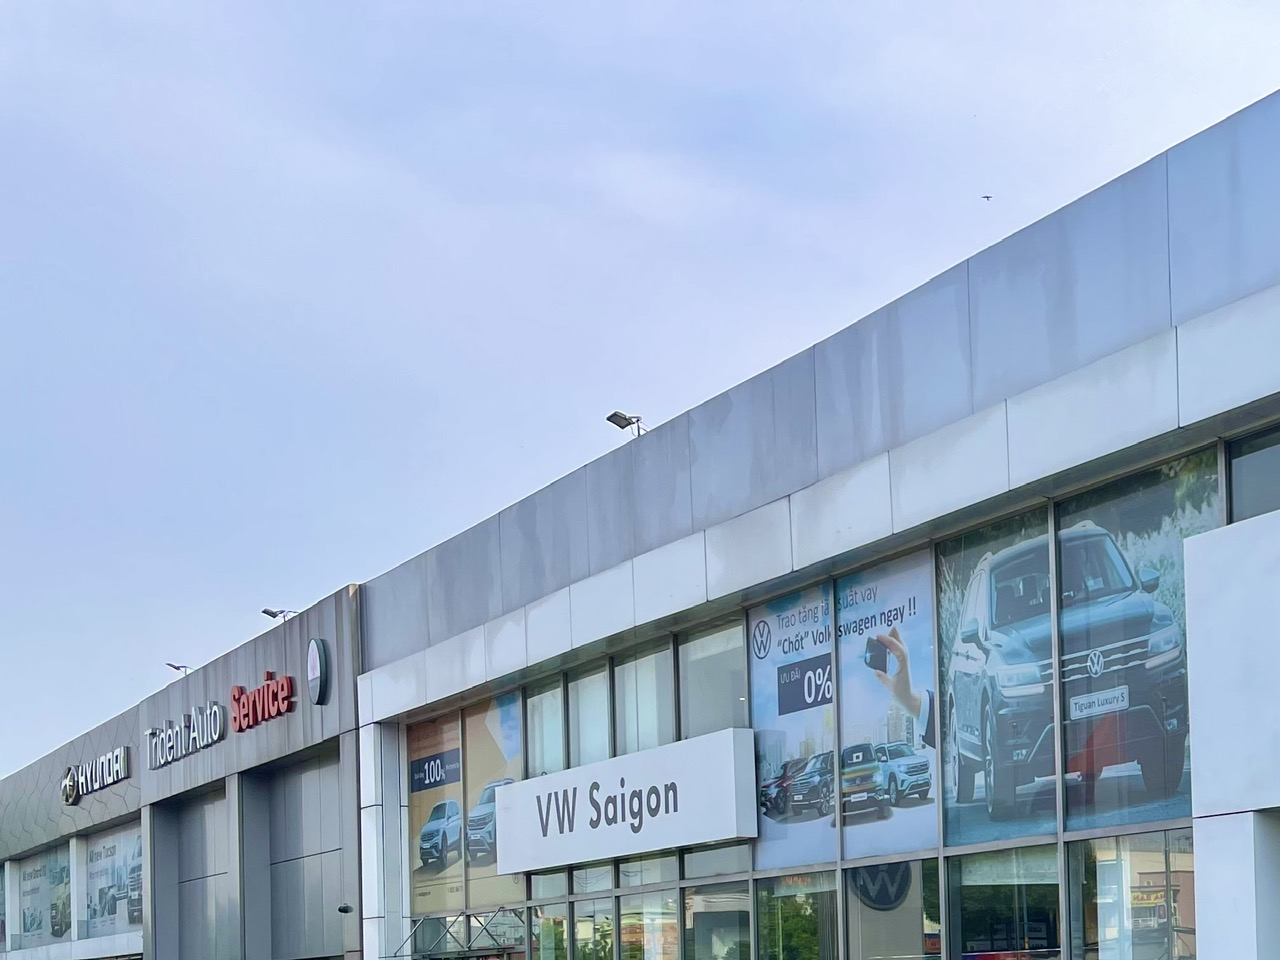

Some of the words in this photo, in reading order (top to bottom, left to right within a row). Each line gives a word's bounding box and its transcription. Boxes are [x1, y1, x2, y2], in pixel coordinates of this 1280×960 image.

[776, 614, 797, 631] Trao
[798, 605, 819, 627] tặng
[861, 585, 878, 603] vay
[880, 604, 905, 628] ngay
[804, 664, 833, 704] 0%
[1074, 701, 1096, 713] Tiguan
[1097, 695, 1120, 707] Luxury
[1120, 692, 1125, 703] S
[144, 714, 187, 771] Trident
[189, 703, 222, 752] Auto
[230, 670, 292, 733] Service
[79, 746, 127, 796] HYUNDAI
[536, 787, 578, 838] VW
[589, 777, 679, 834] Saigon
